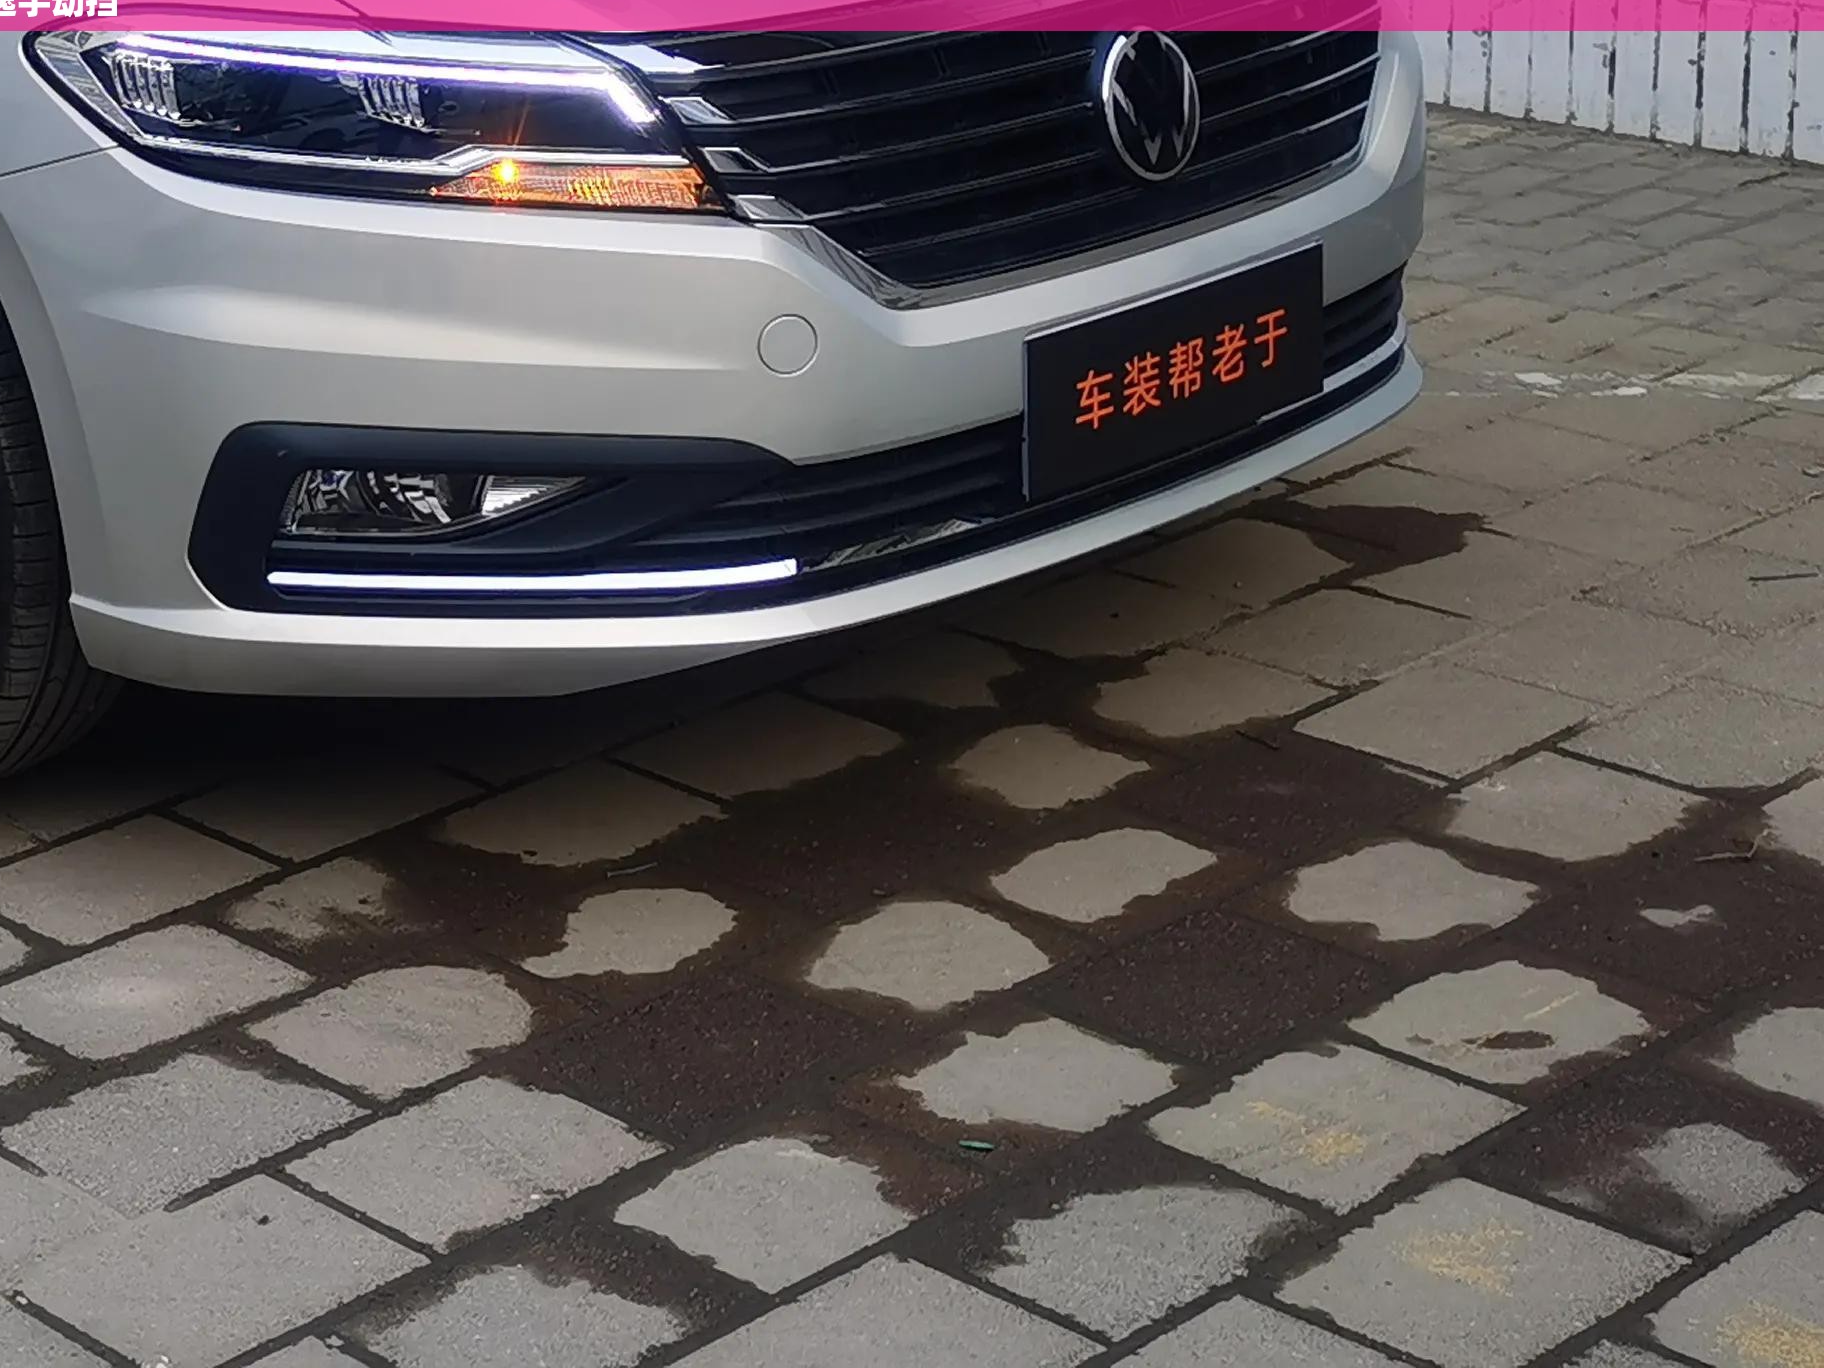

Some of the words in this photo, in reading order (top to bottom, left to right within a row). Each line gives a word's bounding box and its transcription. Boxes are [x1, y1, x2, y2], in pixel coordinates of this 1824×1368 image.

[1075, 308, 1288, 430] 车装帮老于
